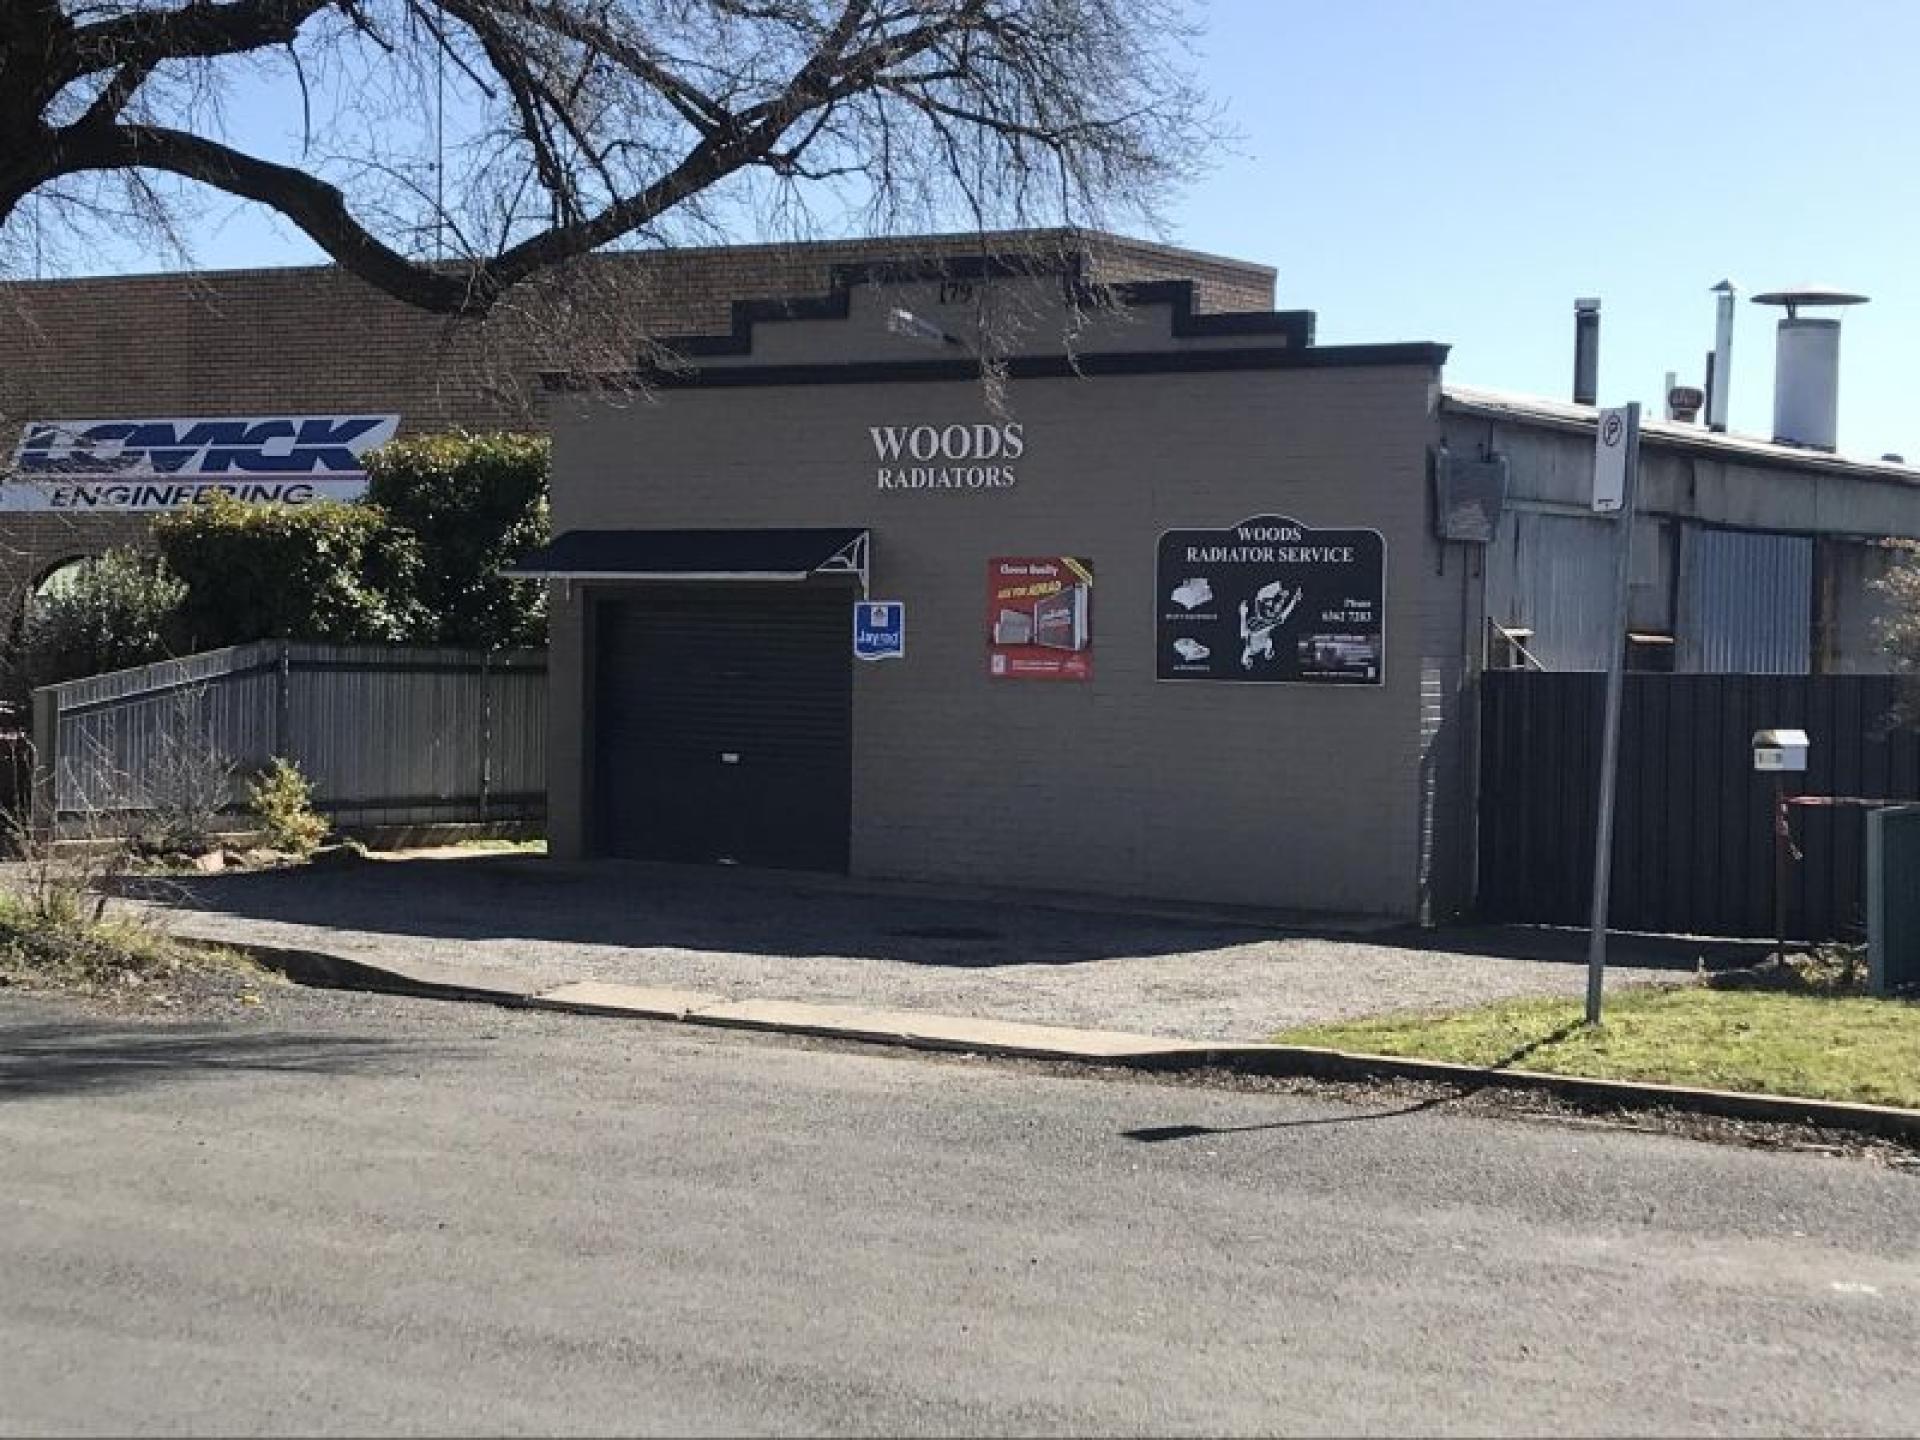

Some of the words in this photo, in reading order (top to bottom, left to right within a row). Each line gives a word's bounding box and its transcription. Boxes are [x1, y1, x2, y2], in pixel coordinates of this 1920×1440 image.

[869, 423, 1024, 461] WOODS
[877, 466, 1016, 488] RADIATORS
[1237, 527, 1302, 541] WOODS
[1186, 547, 1275, 563] RADIATOR
[1278, 547, 1354, 563] SERVICE
